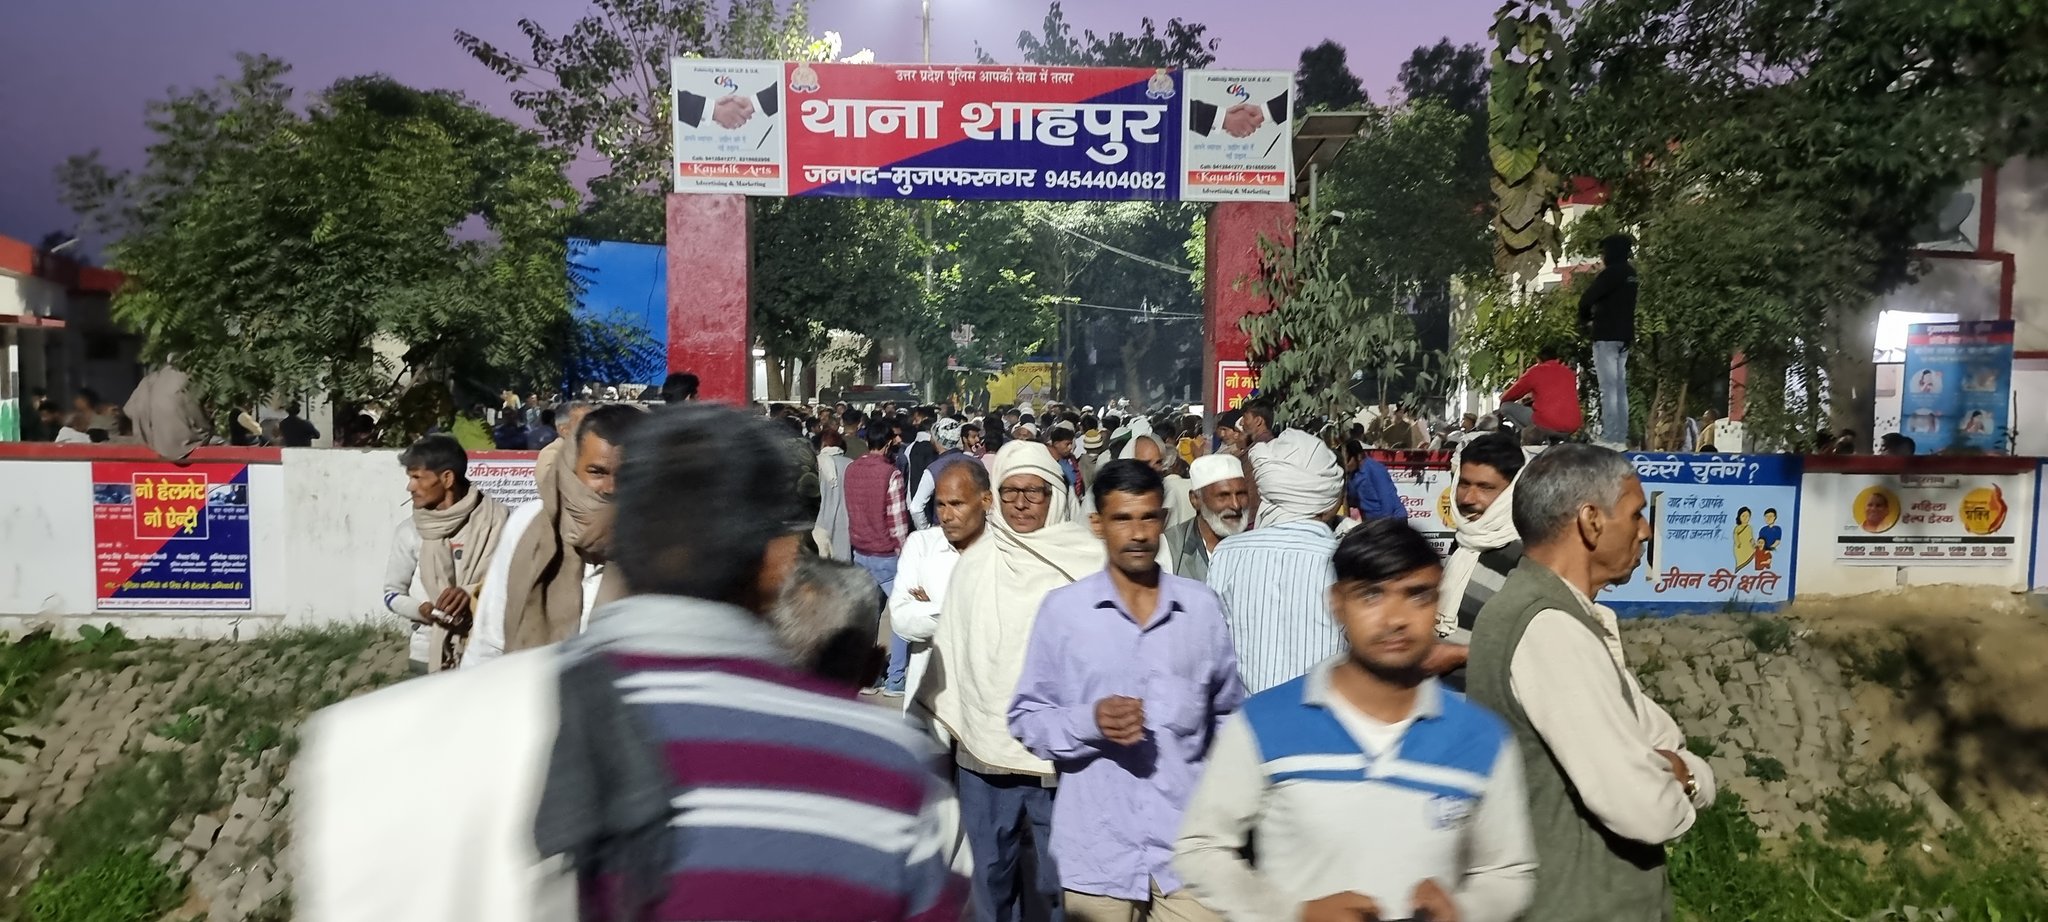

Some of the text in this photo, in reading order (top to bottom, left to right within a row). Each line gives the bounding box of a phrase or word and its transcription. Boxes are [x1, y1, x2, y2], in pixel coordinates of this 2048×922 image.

[896, 66, 1075, 87] उत्तर प्रदेश पुलिस आपकी सेवा में तत्पर
[801, 98, 1168, 166] थाना शाहपुर
[689, 164, 772, 176] Kaushik Arts
[1045, 170, 1166, 190] 9454404082
[1198, 171, 1277, 184] Kaushik Arts
[1225, 372, 1239, 388] नो
[1631, 455, 1685, 480] किसे
[135, 478, 206, 501] नो हेलमेट
[1911, 500, 1947, 512] महिला
[144, 507, 162, 528] नो
[1902, 513, 1953, 524] हेल्प डेस्क
[1655, 566, 1782, 596] जीवन की क्षति
